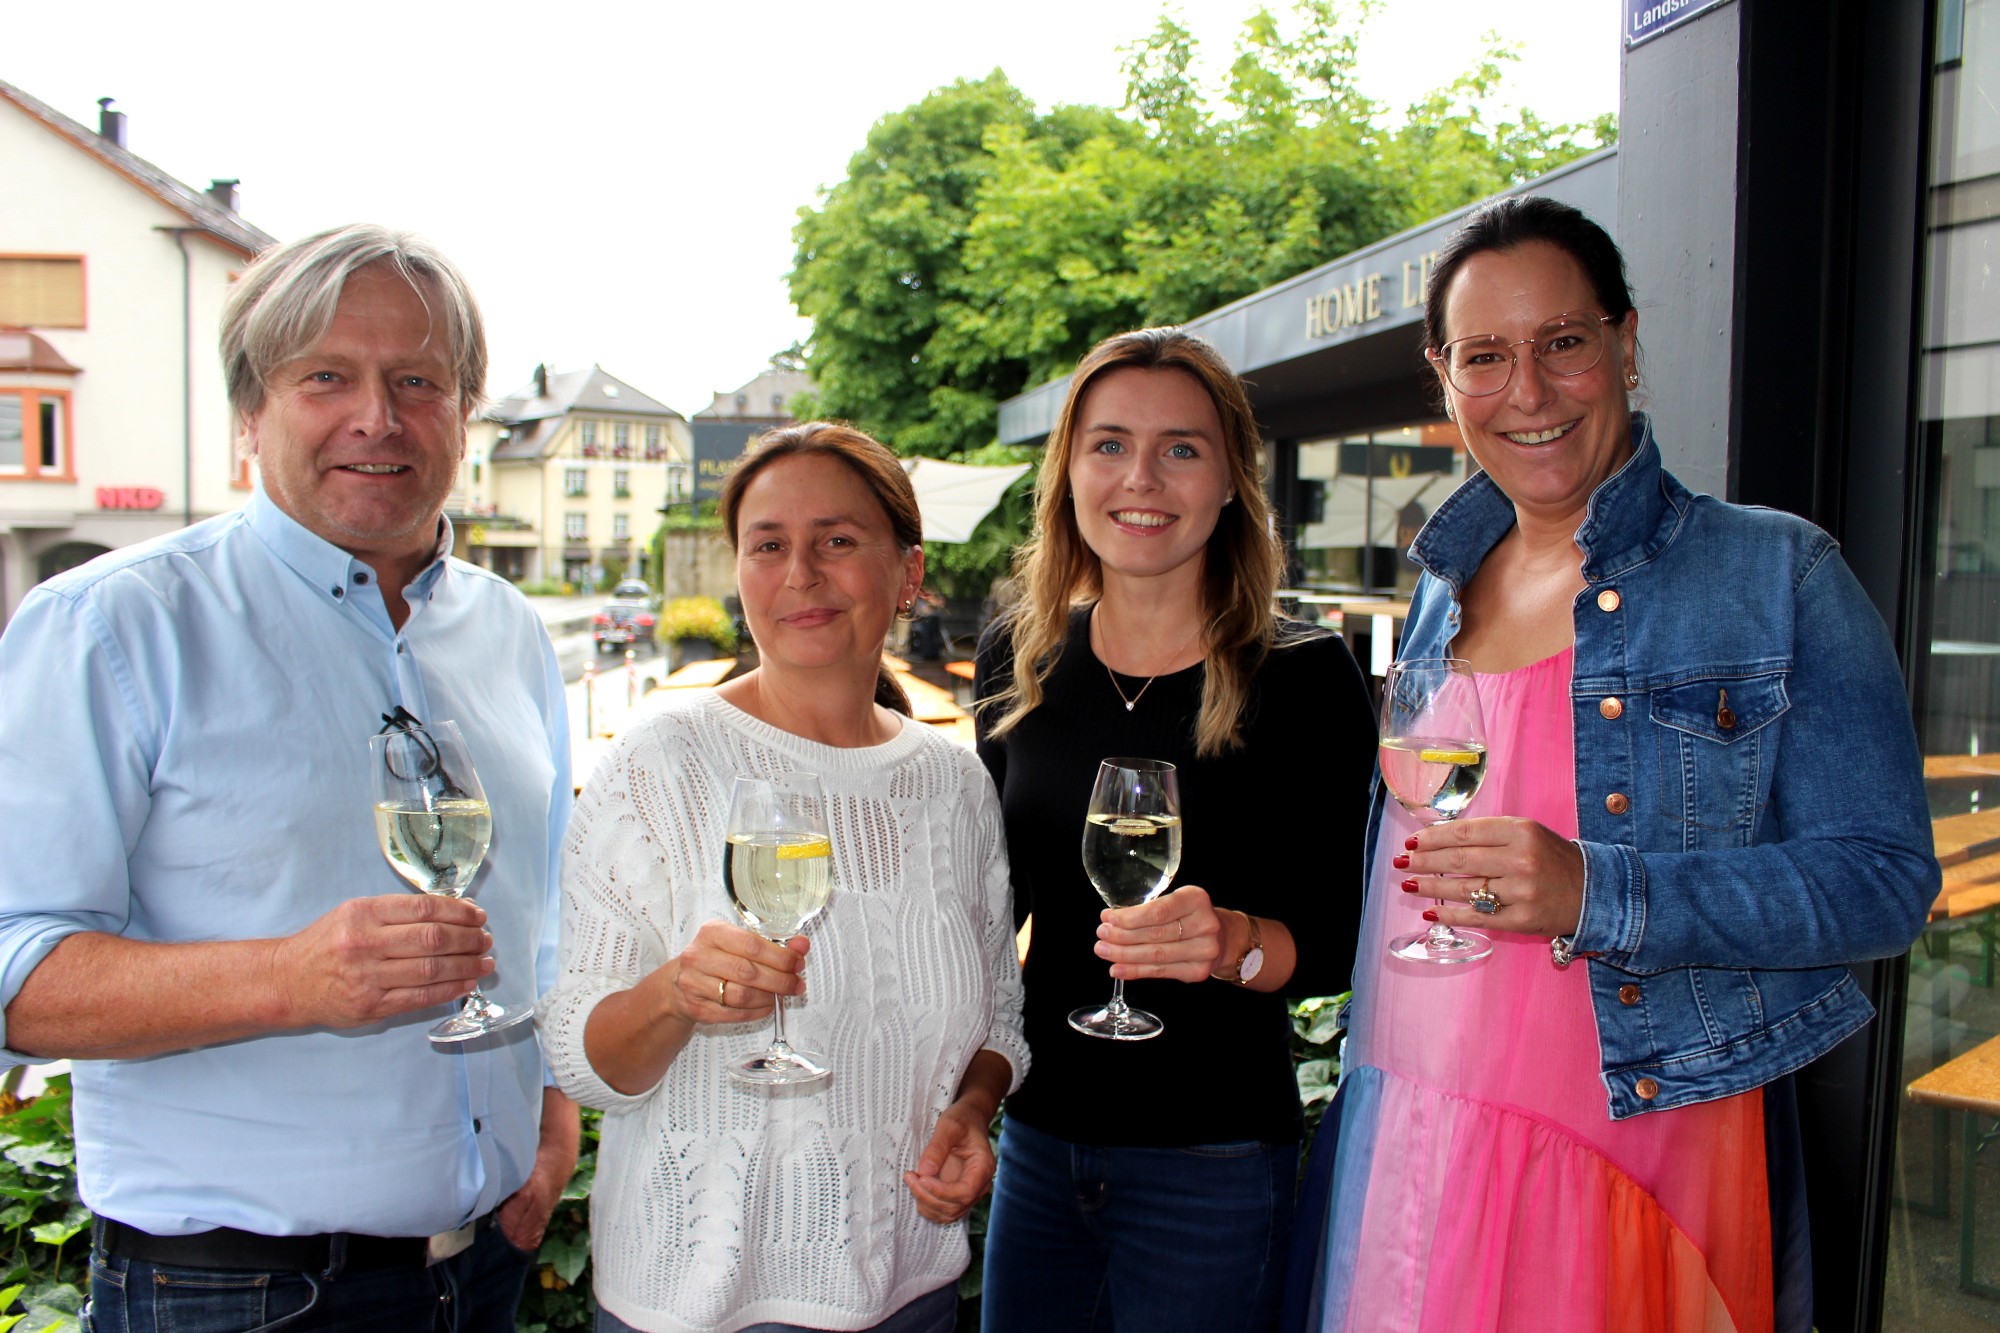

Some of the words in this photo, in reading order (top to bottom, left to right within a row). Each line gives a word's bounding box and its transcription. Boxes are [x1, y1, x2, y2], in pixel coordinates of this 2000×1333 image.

[1633, 0, 1696, 32] Lands
[1305, 271, 1383, 340] HOME
[95, 487, 164, 509] NKD
